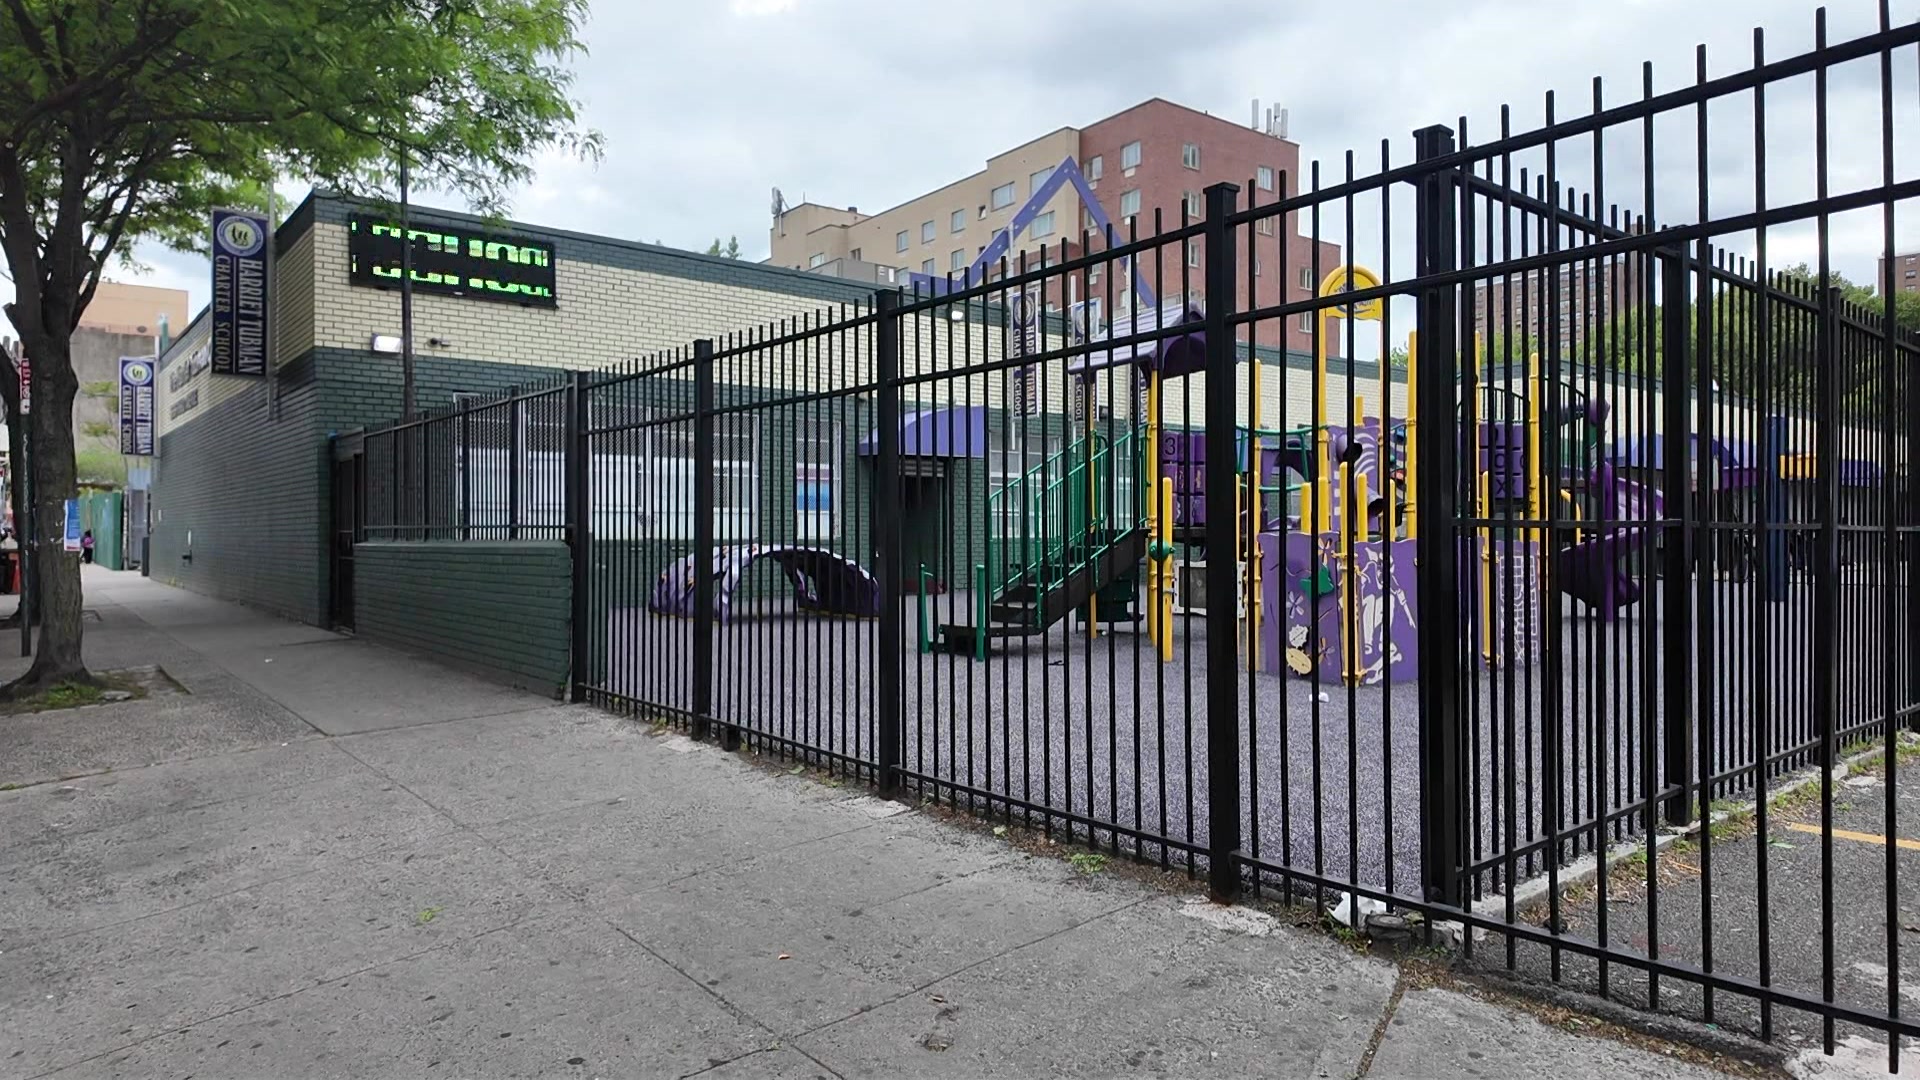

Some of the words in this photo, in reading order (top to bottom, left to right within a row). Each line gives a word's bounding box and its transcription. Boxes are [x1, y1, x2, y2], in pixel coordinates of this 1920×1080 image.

[215, 255, 231, 313] CHARTER
[238, 258, 263, 317] HARRIET
[214, 322, 231, 372] SCHOOL
[238, 320, 263, 375] TUBMAN
[1014, 378, 1023, 416] SCHOOL
[1075, 383, 1083, 420] SCHOOL
